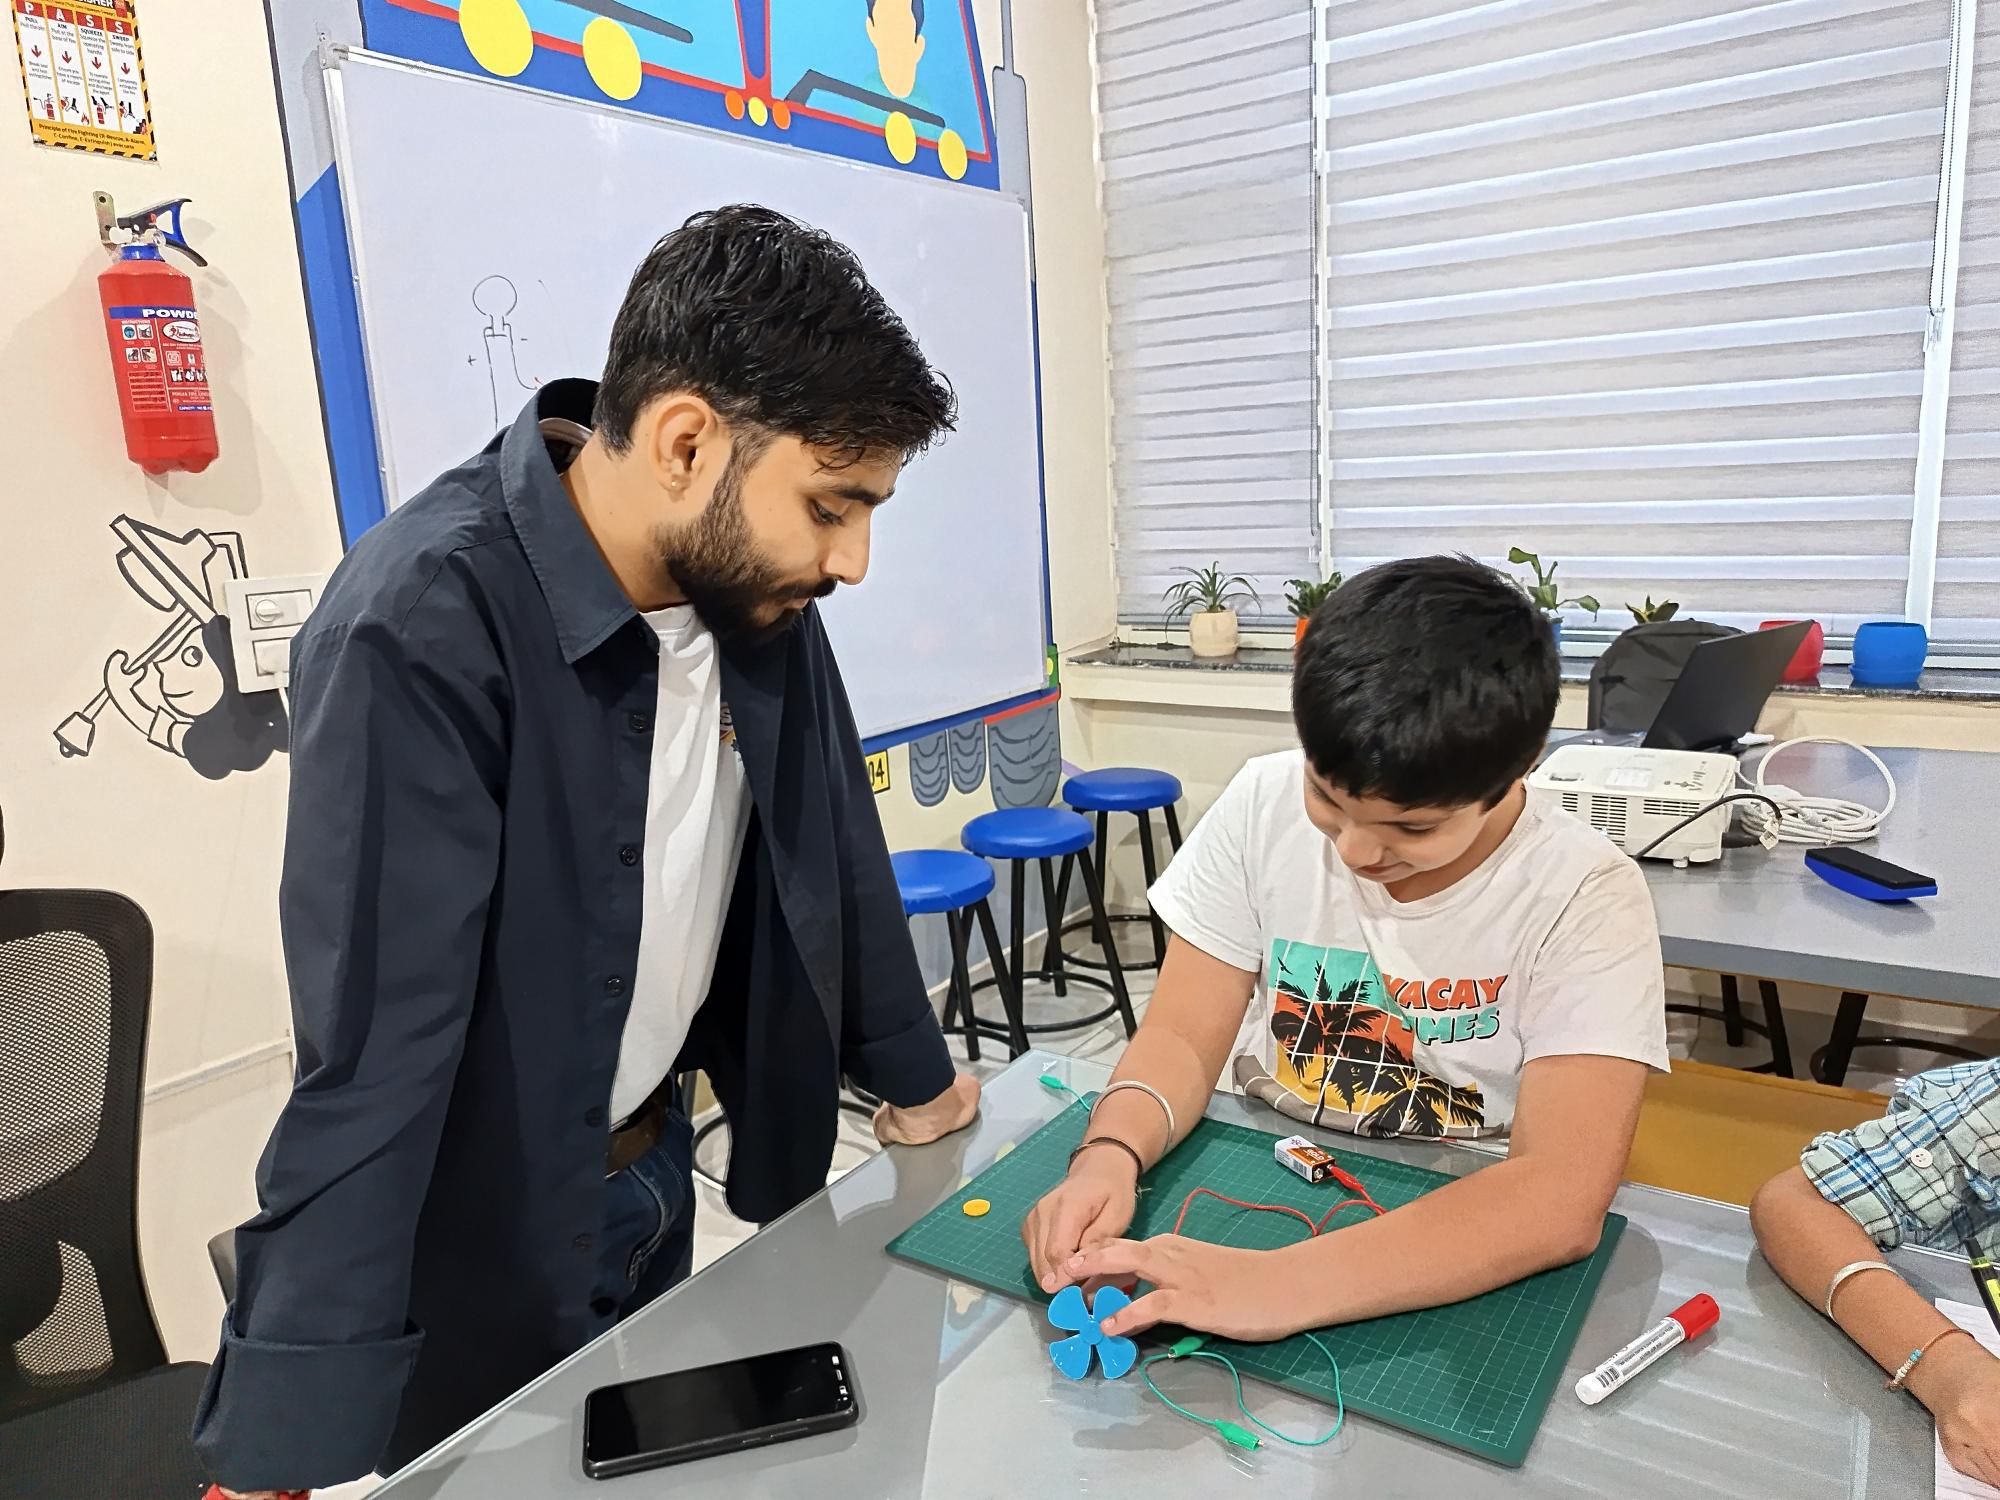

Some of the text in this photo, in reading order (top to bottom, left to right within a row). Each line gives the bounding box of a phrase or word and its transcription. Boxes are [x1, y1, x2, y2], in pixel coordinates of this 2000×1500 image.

[25, 2, 34, 14] P
[56, 8, 65, 21] A
[86, 15, 94, 27] S
[115, 22, 124, 32] S
[80, 28, 103, 36] SQUEEZE
[112, 34, 130, 42] SWEEP
[1382, 973, 1509, 1012] VACAY
